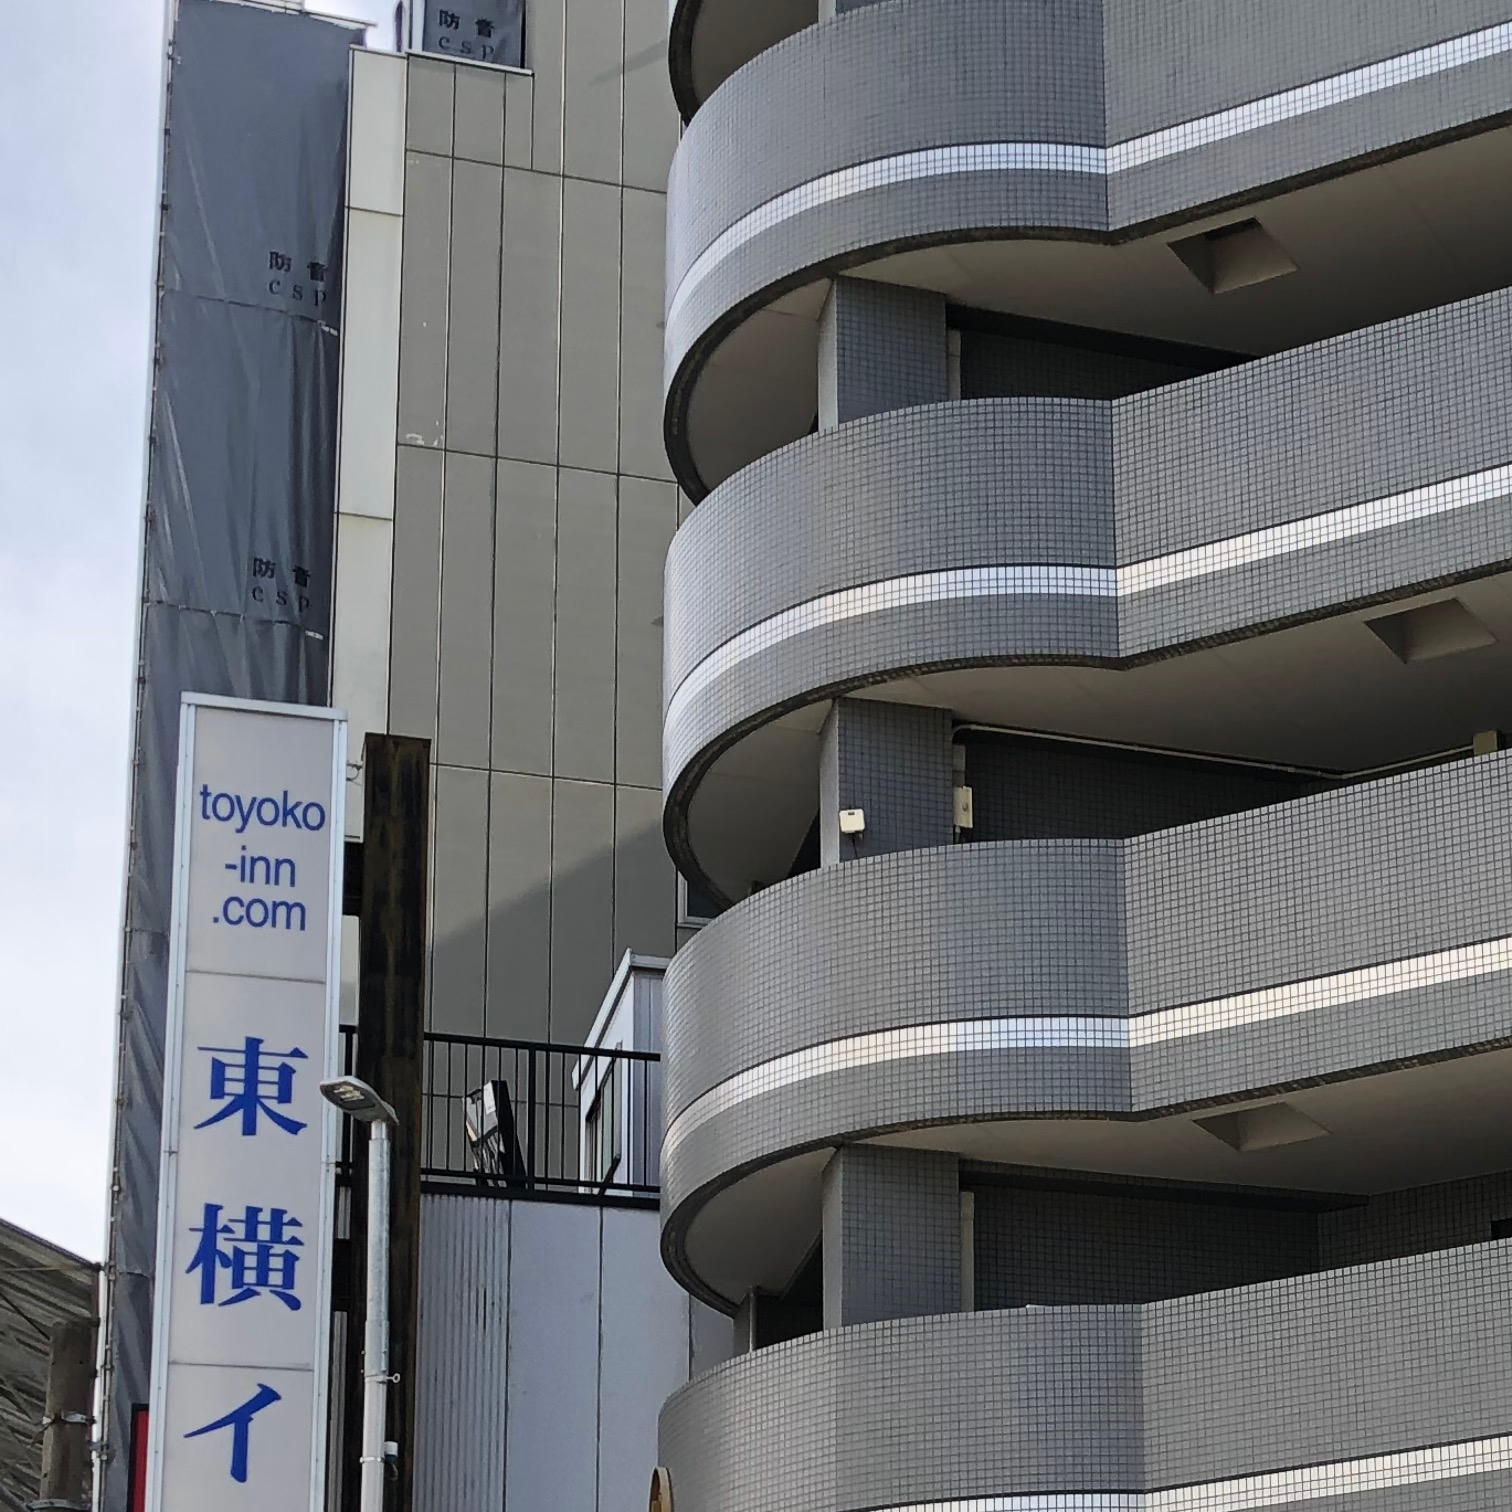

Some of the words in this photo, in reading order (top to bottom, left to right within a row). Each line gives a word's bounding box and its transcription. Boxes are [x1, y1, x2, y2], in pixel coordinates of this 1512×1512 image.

[200, 783, 326, 833] toyoko
[224, 845, 296, 888] -inn
[212, 896, 307, 931] .com
